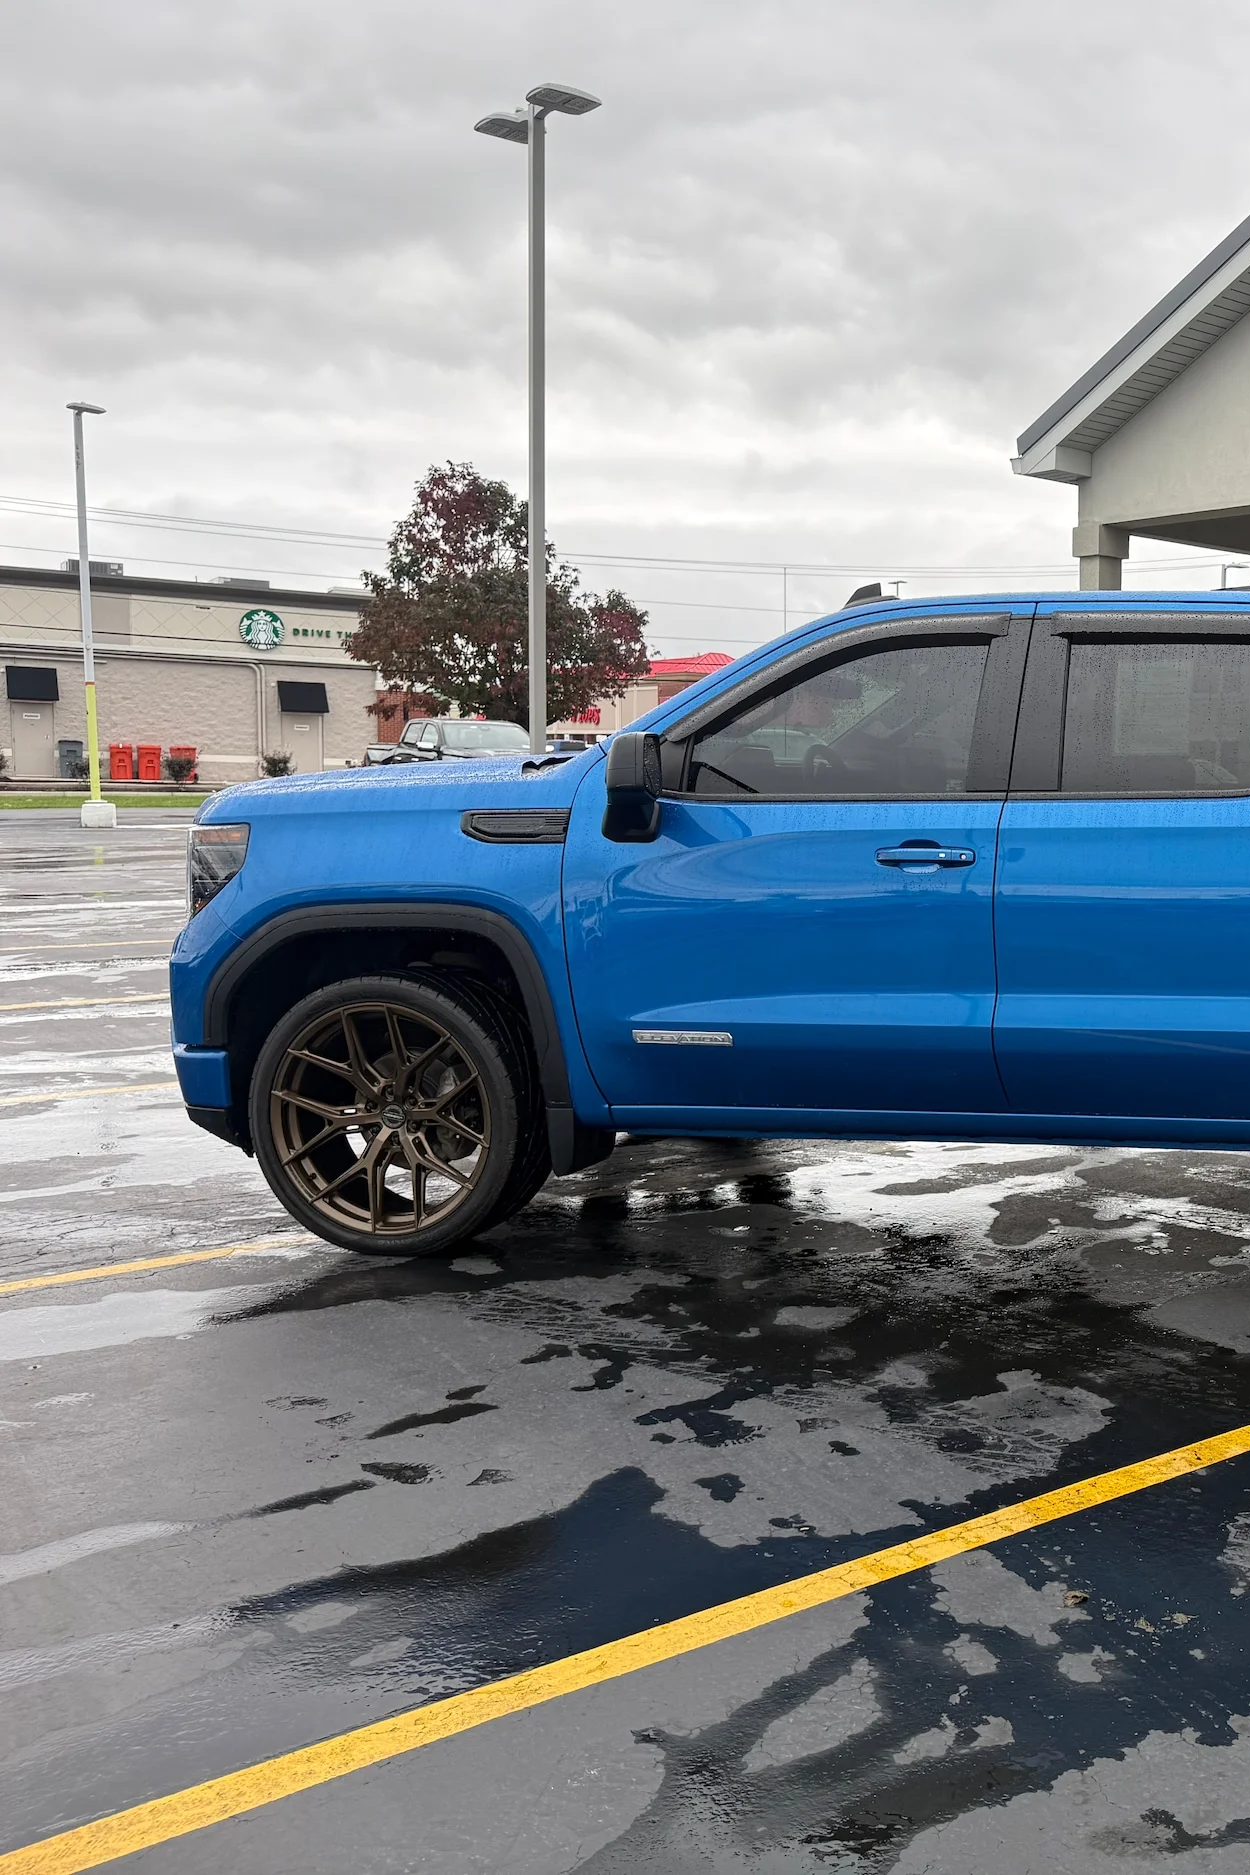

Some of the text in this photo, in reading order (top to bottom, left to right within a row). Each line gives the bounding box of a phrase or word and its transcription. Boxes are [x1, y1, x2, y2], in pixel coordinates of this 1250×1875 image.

[292, 628, 353, 639] DRIVE TH
[637, 1032, 730, 1044] ELEVATION
